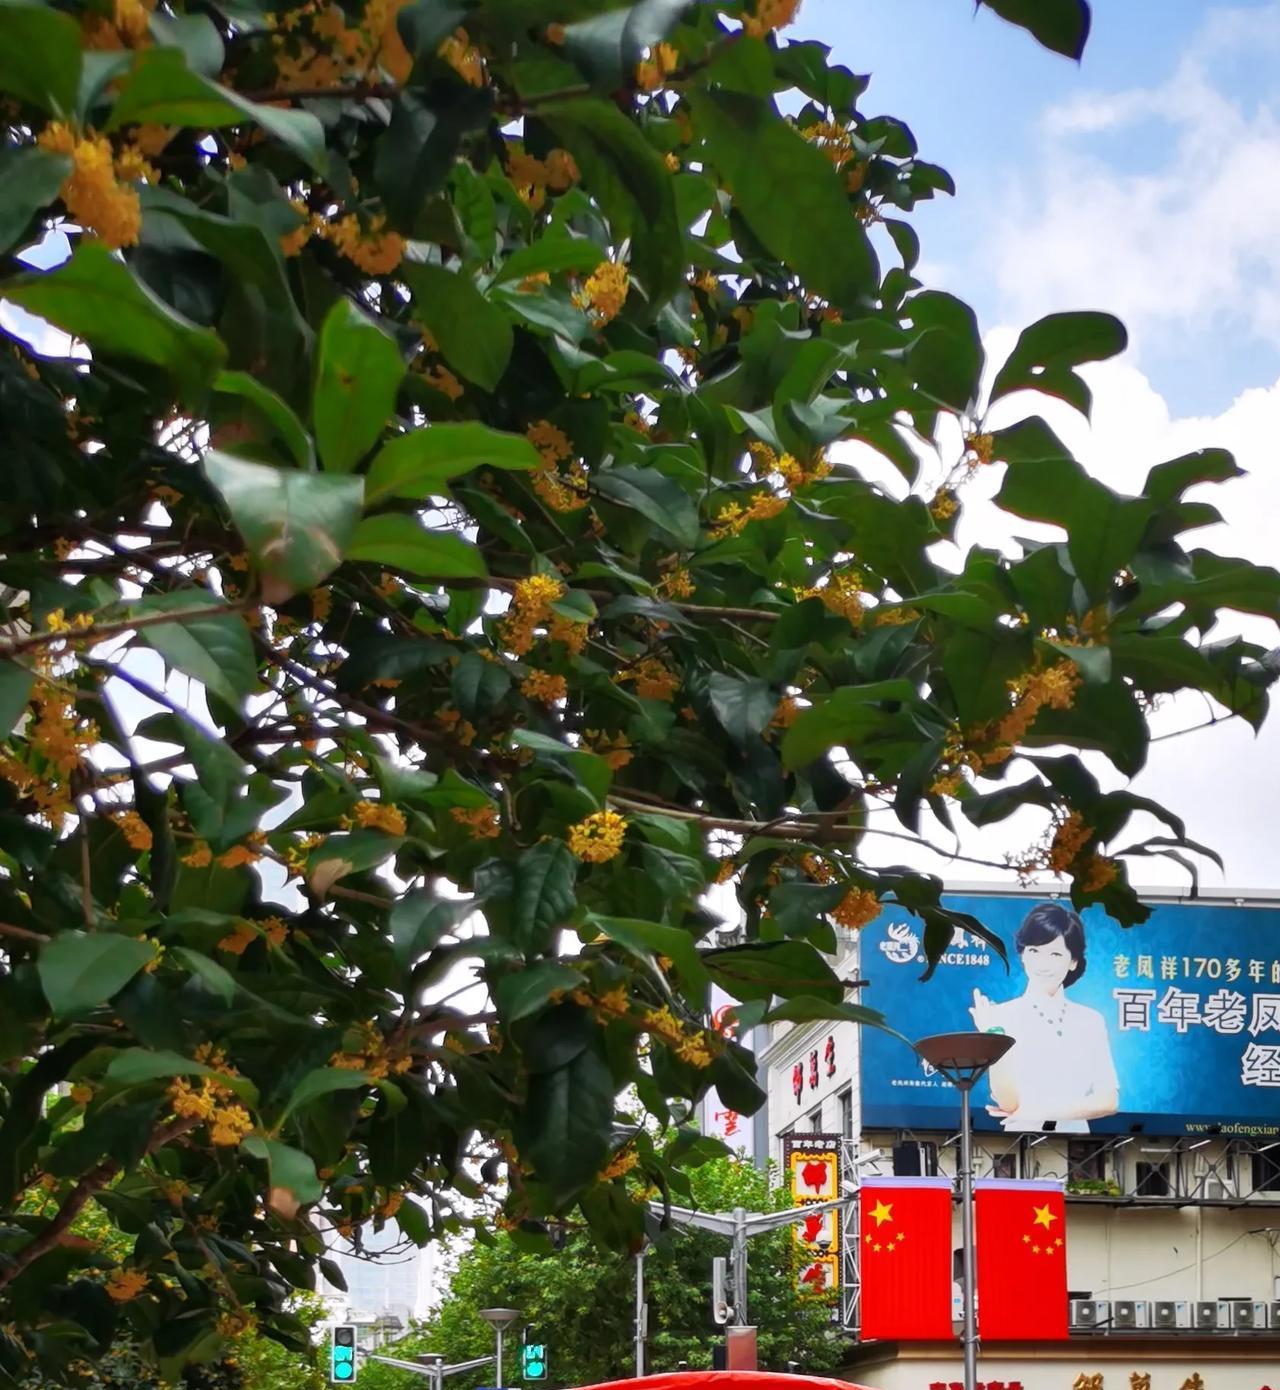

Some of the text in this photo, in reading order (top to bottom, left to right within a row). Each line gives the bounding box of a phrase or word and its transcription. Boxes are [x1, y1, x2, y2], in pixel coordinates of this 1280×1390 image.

[927, 953, 990, 966] NCE1848
[1112, 986, 1280, 1037] 百年老凤
[1241, 1042, 1280, 1087] 经
